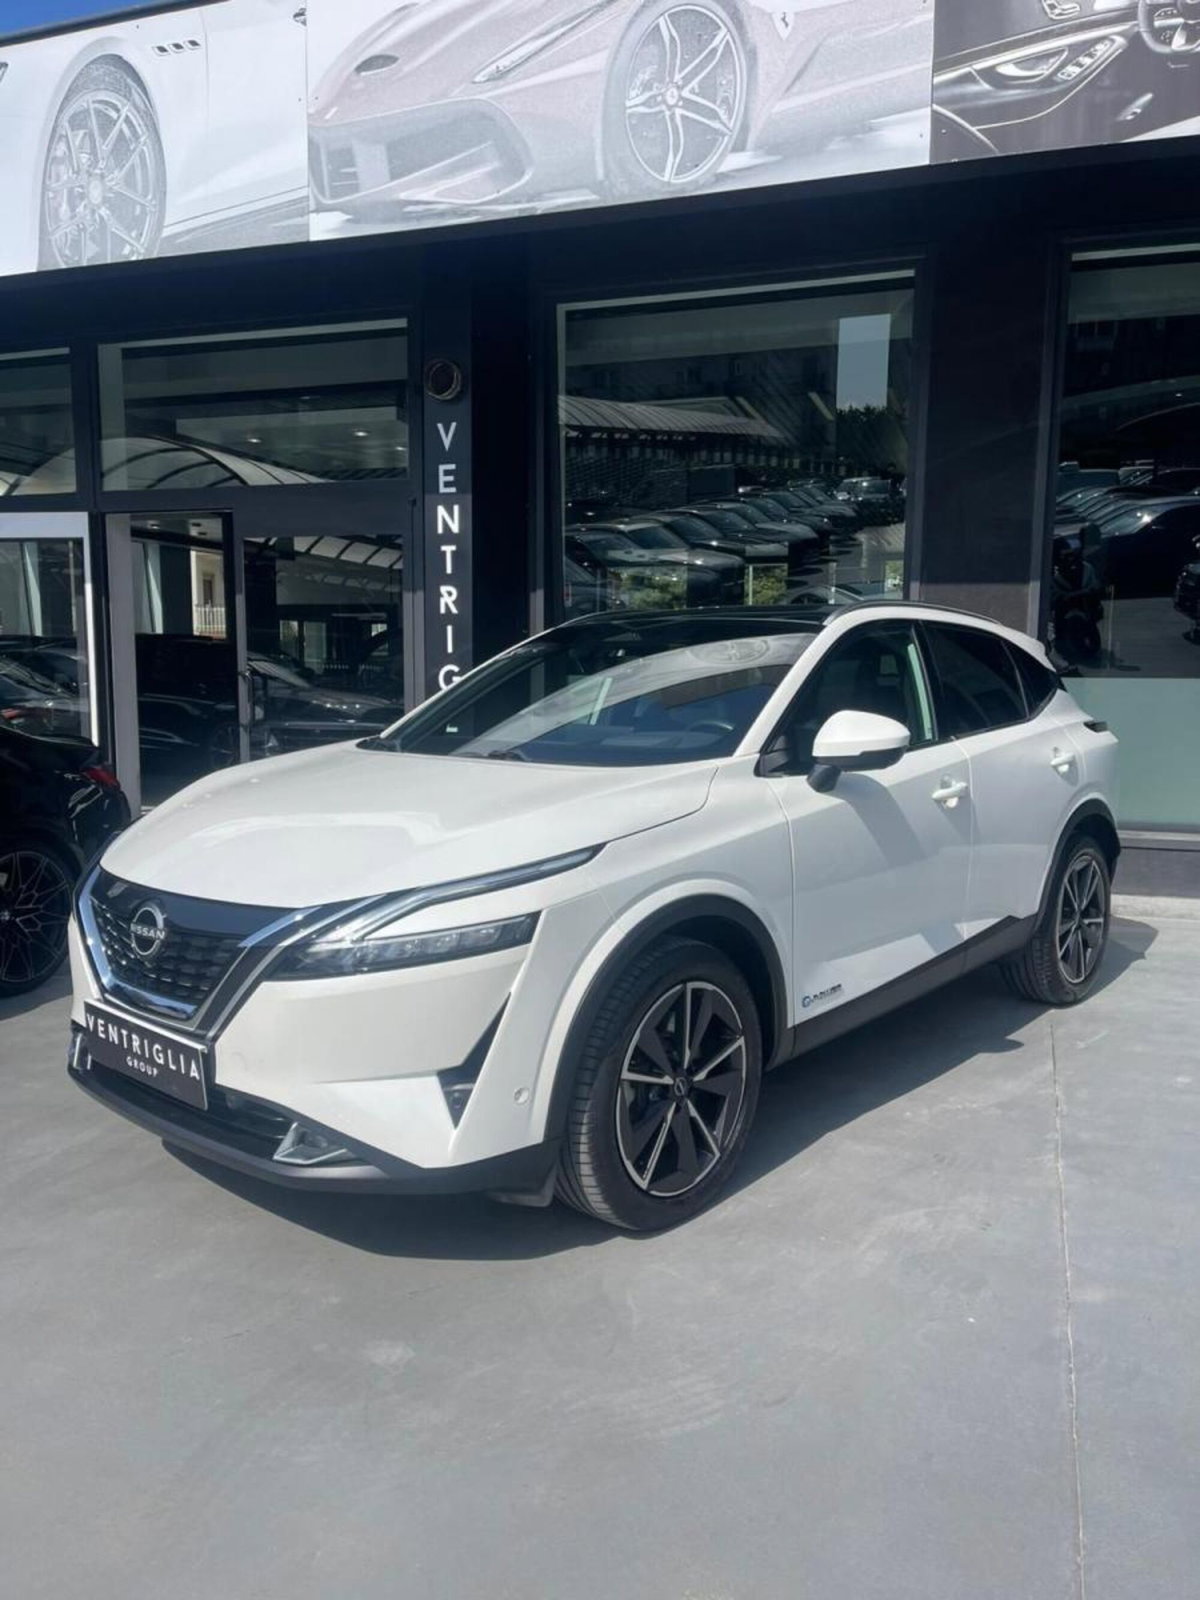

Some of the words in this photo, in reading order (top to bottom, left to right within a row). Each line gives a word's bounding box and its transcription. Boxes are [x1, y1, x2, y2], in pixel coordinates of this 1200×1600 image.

[130, 924, 166, 940] SSAN
[86, 1013, 200, 1081] VENTRIGLIA
[126, 1056, 158, 1077] GROUP
